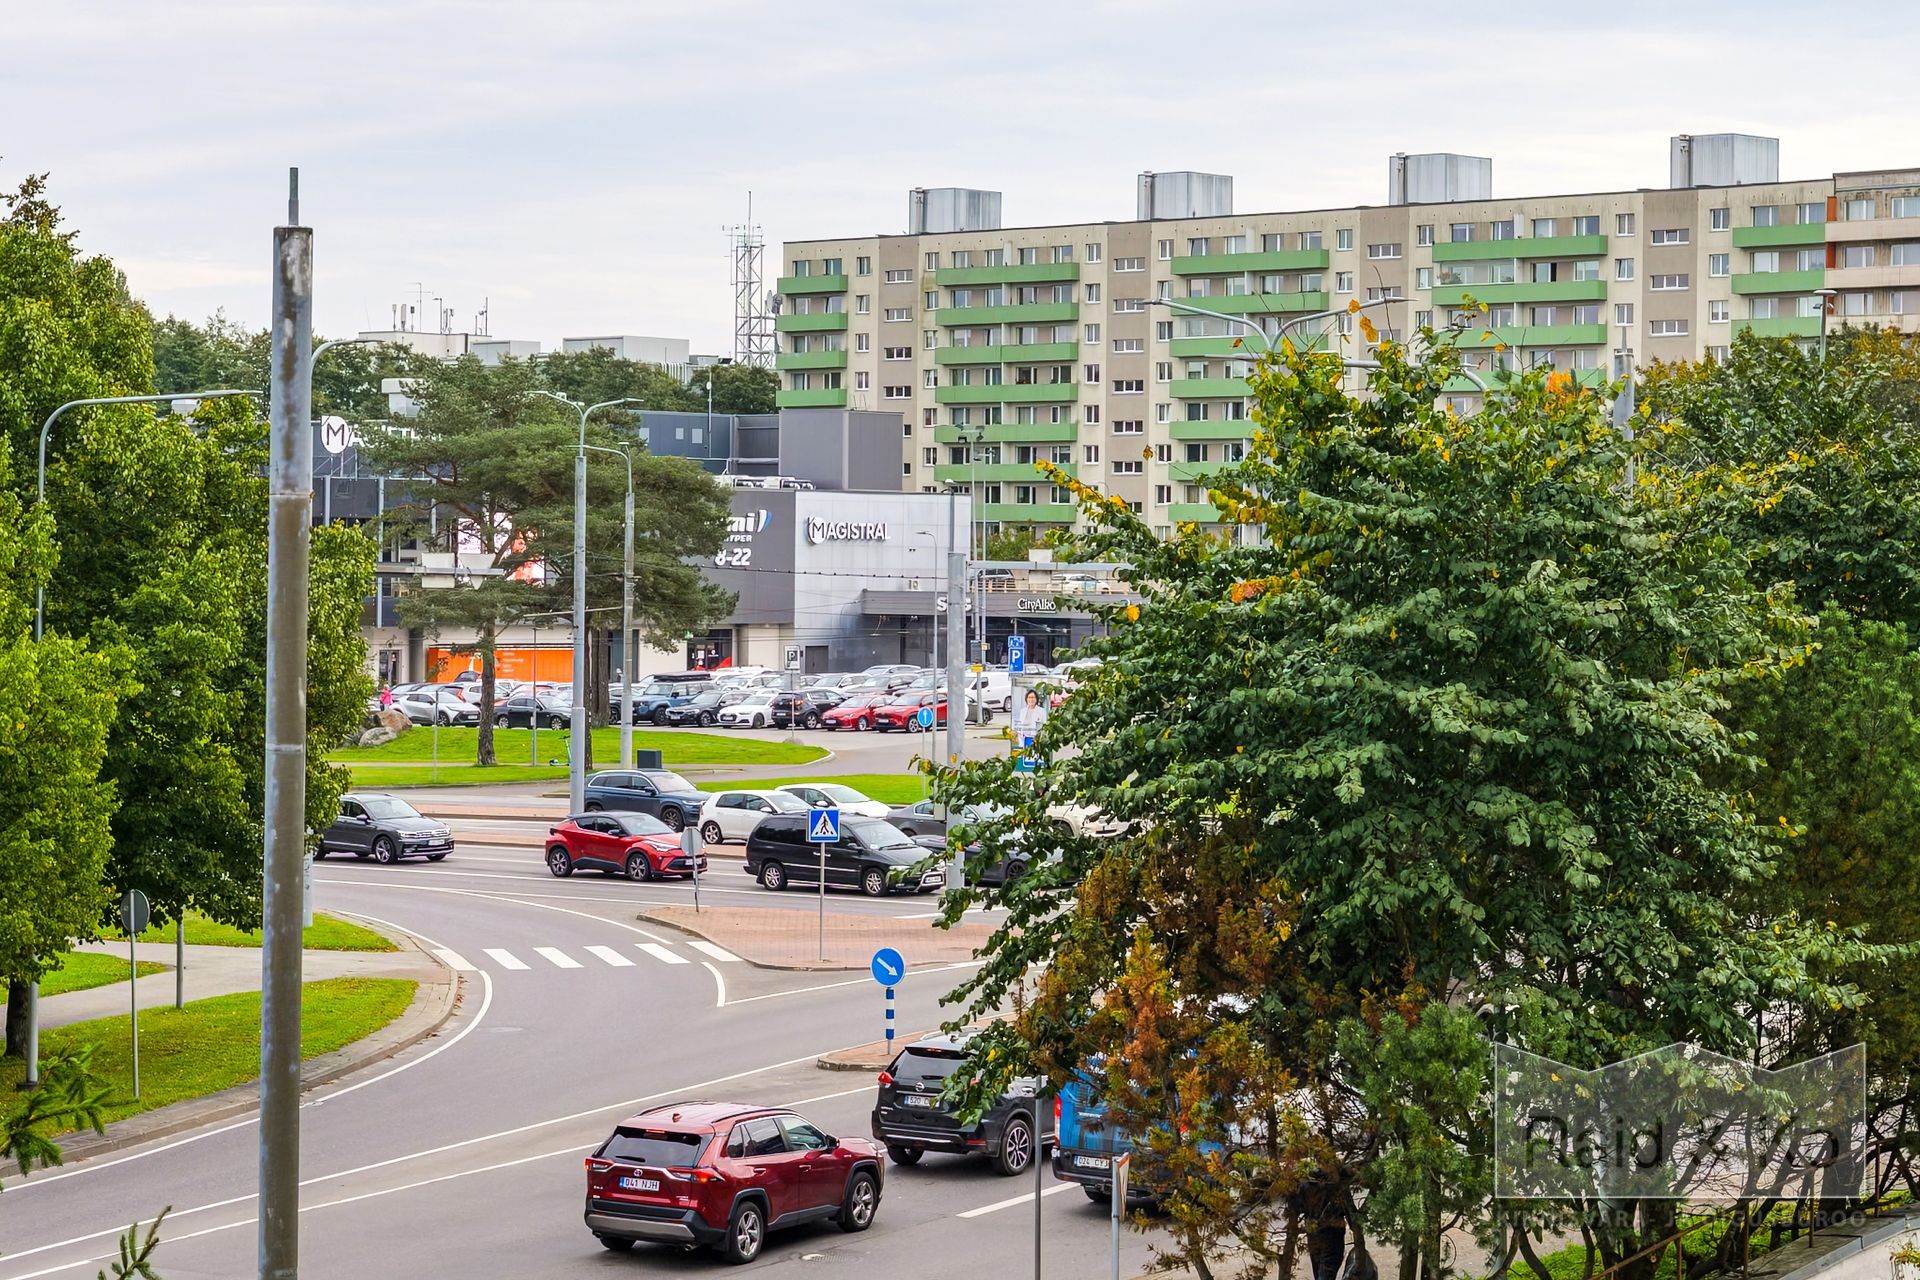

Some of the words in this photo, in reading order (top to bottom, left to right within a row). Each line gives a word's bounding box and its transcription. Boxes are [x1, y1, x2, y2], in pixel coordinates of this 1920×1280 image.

[808, 517, 891, 544] MAGISTRAL
[1017, 597, 1057, 613] CityAlko
[1012, 650, 1020, 663] P
[625, 1179, 638, 1187] 041
[641, 1180, 658, 1189] NJH
